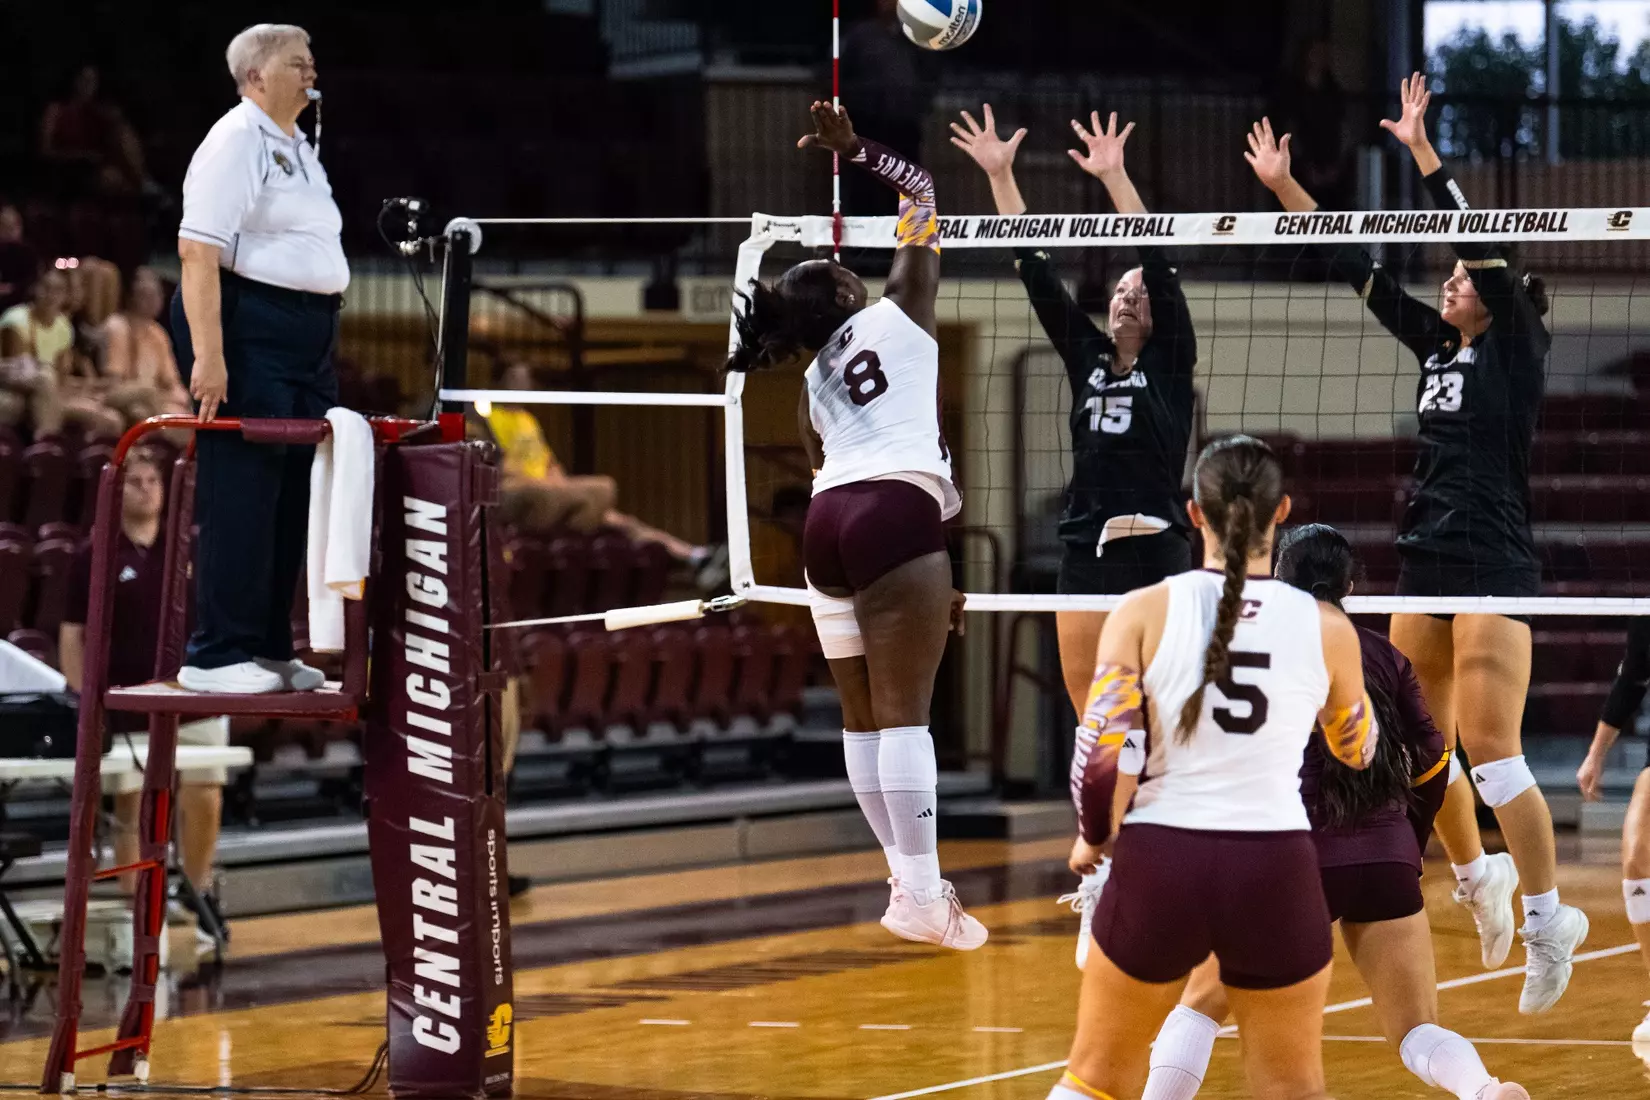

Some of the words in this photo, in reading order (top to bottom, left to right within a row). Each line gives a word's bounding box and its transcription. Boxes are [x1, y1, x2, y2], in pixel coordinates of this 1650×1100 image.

[938, 5, 967, 46] molten
[974, 217, 1062, 239] MICHIGAN
[1068, 216, 1176, 238] VOLLEYBALL
[1274, 214, 1354, 236] CENTRAL
[1358, 213, 1454, 235] MICHIGAN
[1456, 211, 1569, 234] VOLLEYBALL
[843, 349, 889, 407] 8
[1418, 371, 1464, 413] 23
[1085, 395, 1134, 434] 15
[403, 495, 453, 784] MICHIGAN
[1212, 651, 1271, 735] 5
[487, 828, 499, 898] sports
[409, 816, 461, 1055] CENTRAL
[489, 900, 504, 986] imports
